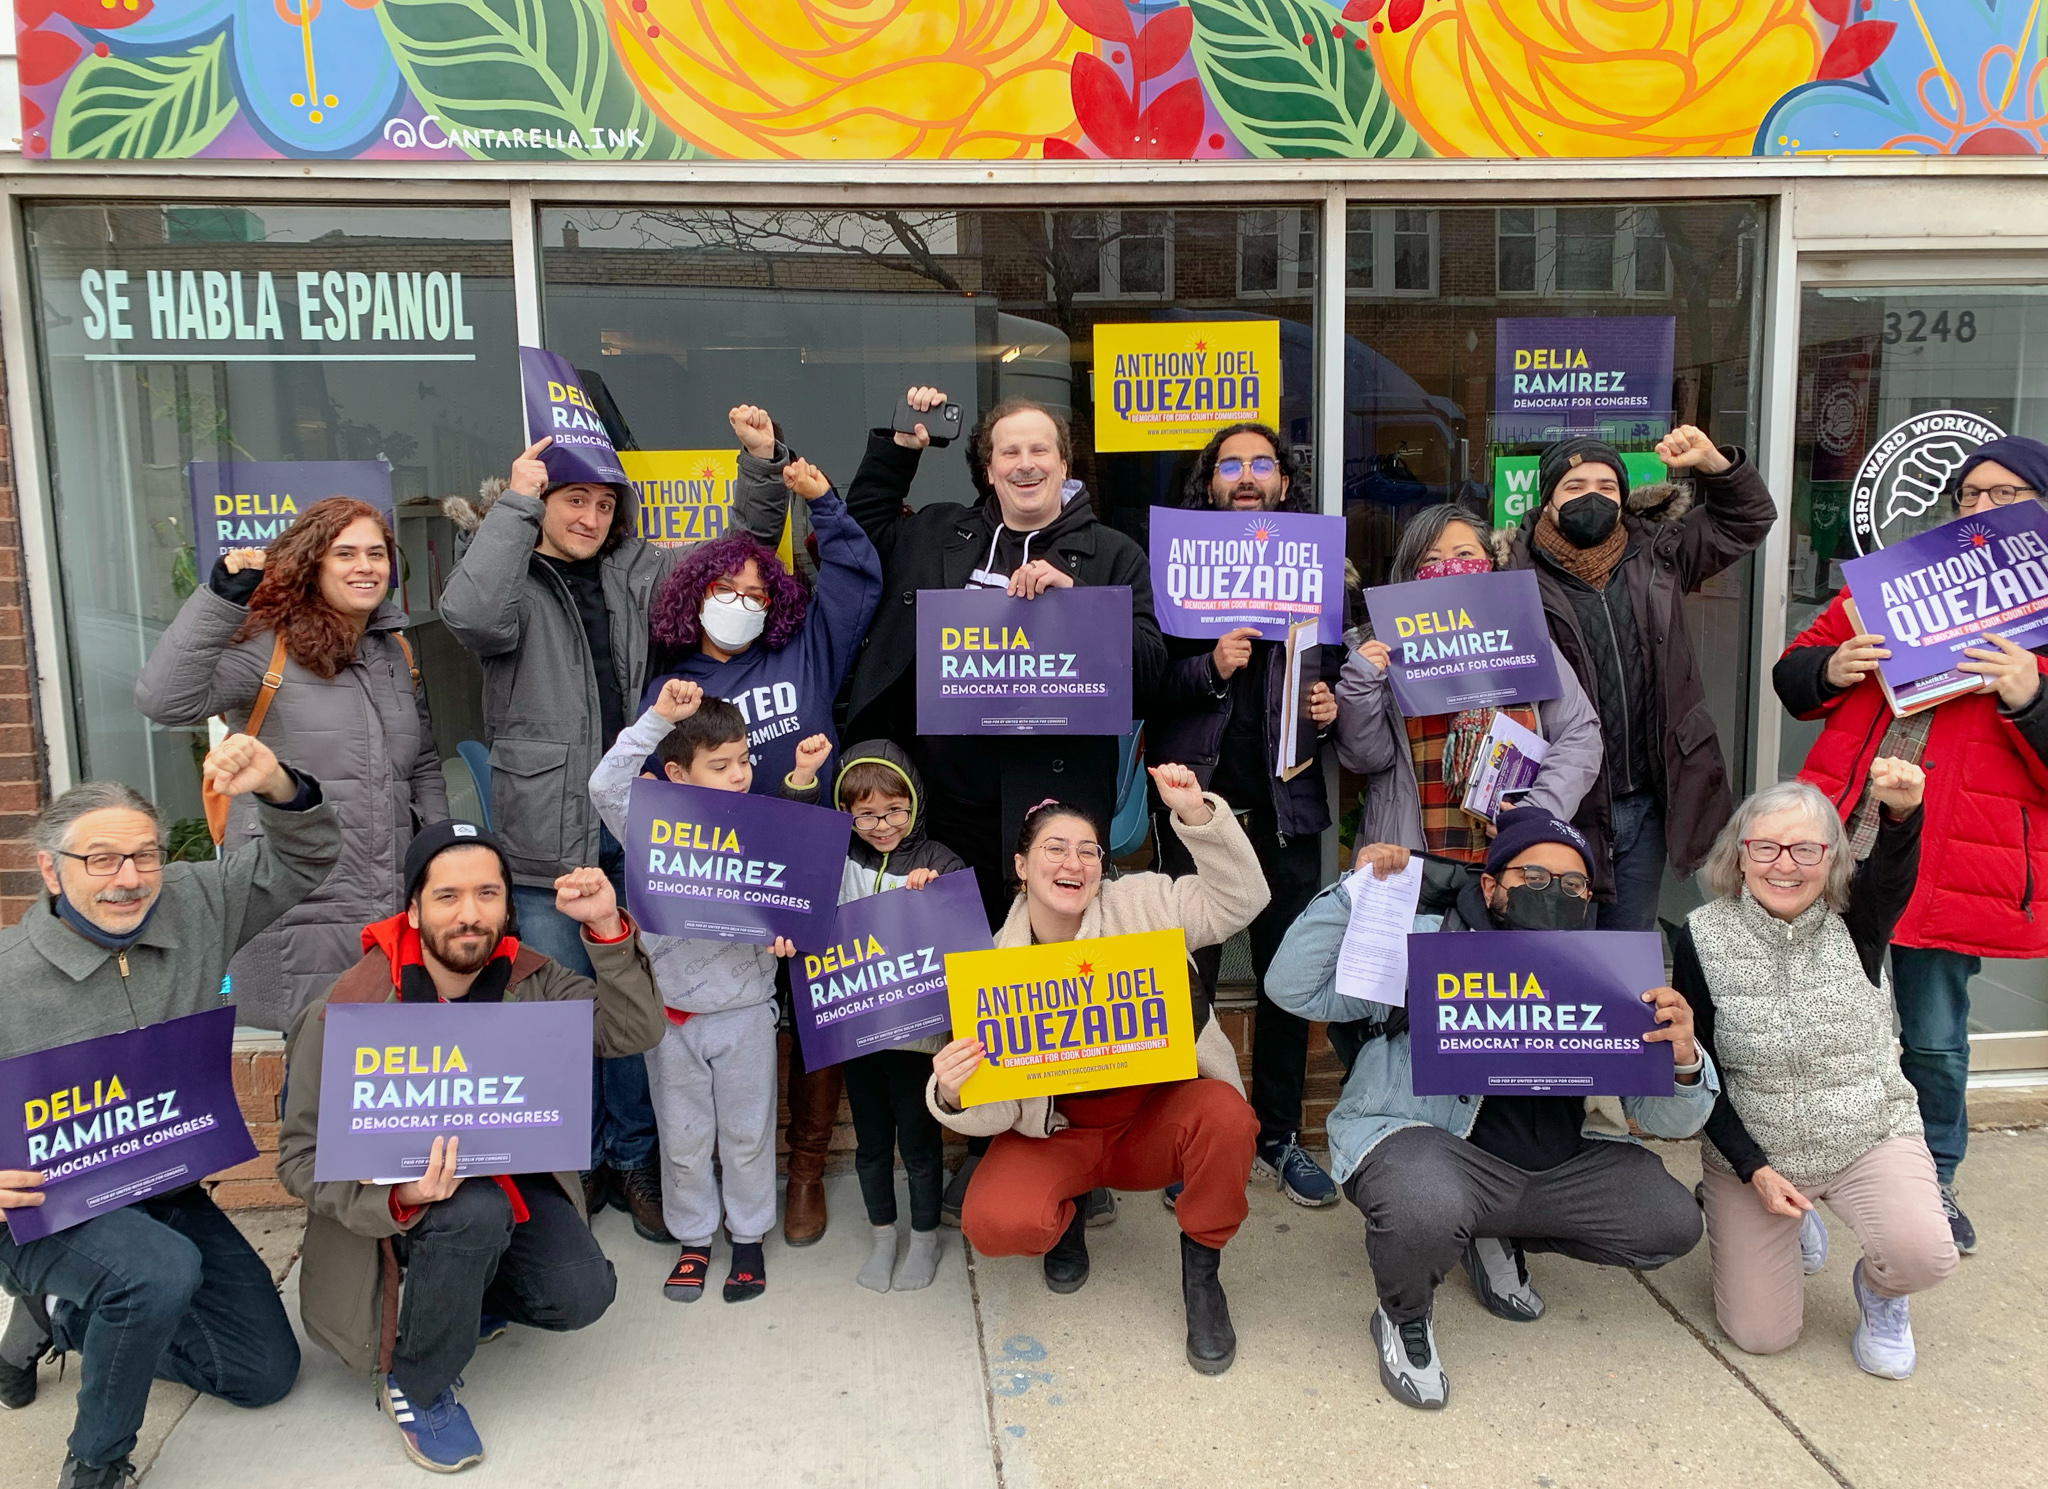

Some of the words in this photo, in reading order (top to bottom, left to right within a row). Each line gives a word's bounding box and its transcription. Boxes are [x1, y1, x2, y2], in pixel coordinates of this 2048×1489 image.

[80, 268, 133, 340] SE
[146, 270, 284, 340] HABLA
[297, 270, 474, 341] ESPANOL
[1884, 310, 1977, 344] 3248
[1115, 352, 1207, 377] ANTHONY
[1214, 351, 1259, 376] JOEL
[1515, 348, 1588, 369] DELIA
[547, 381, 600, 417] DELI
[1113, 376, 1259, 420] QUEZADA
[1514, 371, 1625, 394] RAMIREZ
[1131, 414, 1161, 422] DEMOCRAT
[1163, 413, 1174, 421] FOR
[1175, 413, 1191, 421] COOK
[1191, 412, 1213, 421] COUNTY
[1215, 411, 1257, 420] COMMISSIONER
[1514, 398, 1569, 408] DEMOCRAT
[1572, 397, 1592, 406] FOR
[1595, 397, 1648, 406] CONGRESS
[1911, 416, 1998, 443] WORKING
[1862, 432, 1907, 479] WARD
[214, 494, 298, 515] DELIA
[1855, 486, 1871, 535] 33RD
[633, 505, 733, 539] UEZA
[1168, 538, 1269, 566] ANTHONY
[1274, 541, 1323, 569] JOEL
[1167, 563, 1323, 606] QUEZADA
[1880, 543, 1998, 609] ANTHONY
[1184, 600, 1216, 609] DEMOCRAT
[1218, 600, 1229, 609] FOR
[1231, 600, 1247, 609] COOK
[1249, 600, 1272, 610] COUNTY
[1274, 602, 1320, 613] COMMISSIONER
[1886, 554, 2048, 648] QUEZAD
[942, 626, 1030, 650] DELIA
[1395, 608, 1474, 638] DELIA
[1923, 628, 1964, 646] DEMOCRAT
[1965, 622, 1981, 634] FOR
[1980, 615, 2002, 630] COOK
[2001, 606, 2033, 623] COUNTY
[1402, 629, 1513, 664] RAMIREZ
[942, 653, 1077, 678] RAMIREZ
[1406, 662, 1465, 680] DEMOCRAT
[1468, 659, 1488, 672] FOR
[1490, 654, 1536, 669] CONGRESS
[721, 682, 797, 725] TED
[942, 684, 1008, 695] DEMOCRAT
[1012, 684, 1037, 694] FOR
[1040, 683, 1106, 694] CONGRESS
[651, 819, 740, 853] DELIA
[649, 849, 787, 888] RAMIREZ
[648, 880, 713, 897] DEMOCRAT
[716, 888, 740, 900] FOR
[743, 891, 811, 910] CONGRESS
[804, 934, 885, 980] DELIA
[809, 946, 940, 1008] RAMIREZ
[976, 975, 1095, 1018] ANTHONY
[1106, 967, 1163, 1001] JOEL
[1437, 972, 1545, 999] DELIA
[815, 997, 874, 1025] DEMOCRAT
[879, 991, 904, 1005] FOR
[1438, 1004, 1603, 1031] RAMIREZ
[976, 997, 1168, 1066] QUEZADA
[1440, 1038, 1519, 1050] DEMOCRAT
[1525, 1038, 1554, 1049] FOR
[1559, 1038, 1640, 1050] CONGRESS
[354, 1045, 467, 1075] DELIA
[1004, 1054, 1043, 1067] DEMOCRAT
[1045, 1053, 1059, 1063] FOR
[1061, 1050, 1080, 1062] COOK
[1081, 1046, 1110, 1058] COUNTY
[1112, 1039, 1167, 1054] COMMISSIONER
[1026, 1062, 1128, 1080] WWW.ANTHONYFORCOOKCOUNTY.ORG
[24, 1074, 126, 1131] DELIA
[353, 1076, 525, 1110] RAMIREZ
[28, 1090, 180, 1166] RAMIREZ
[352, 1115, 438, 1131] DEMOCRAT
[443, 1113, 473, 1127] FOR
[478, 1110, 560, 1125] CONGRESS
[40, 1150, 107, 1183] EMOCRAT
[112, 1139, 140, 1158] FOR
[143, 1114, 214, 1148] CONGRESS
